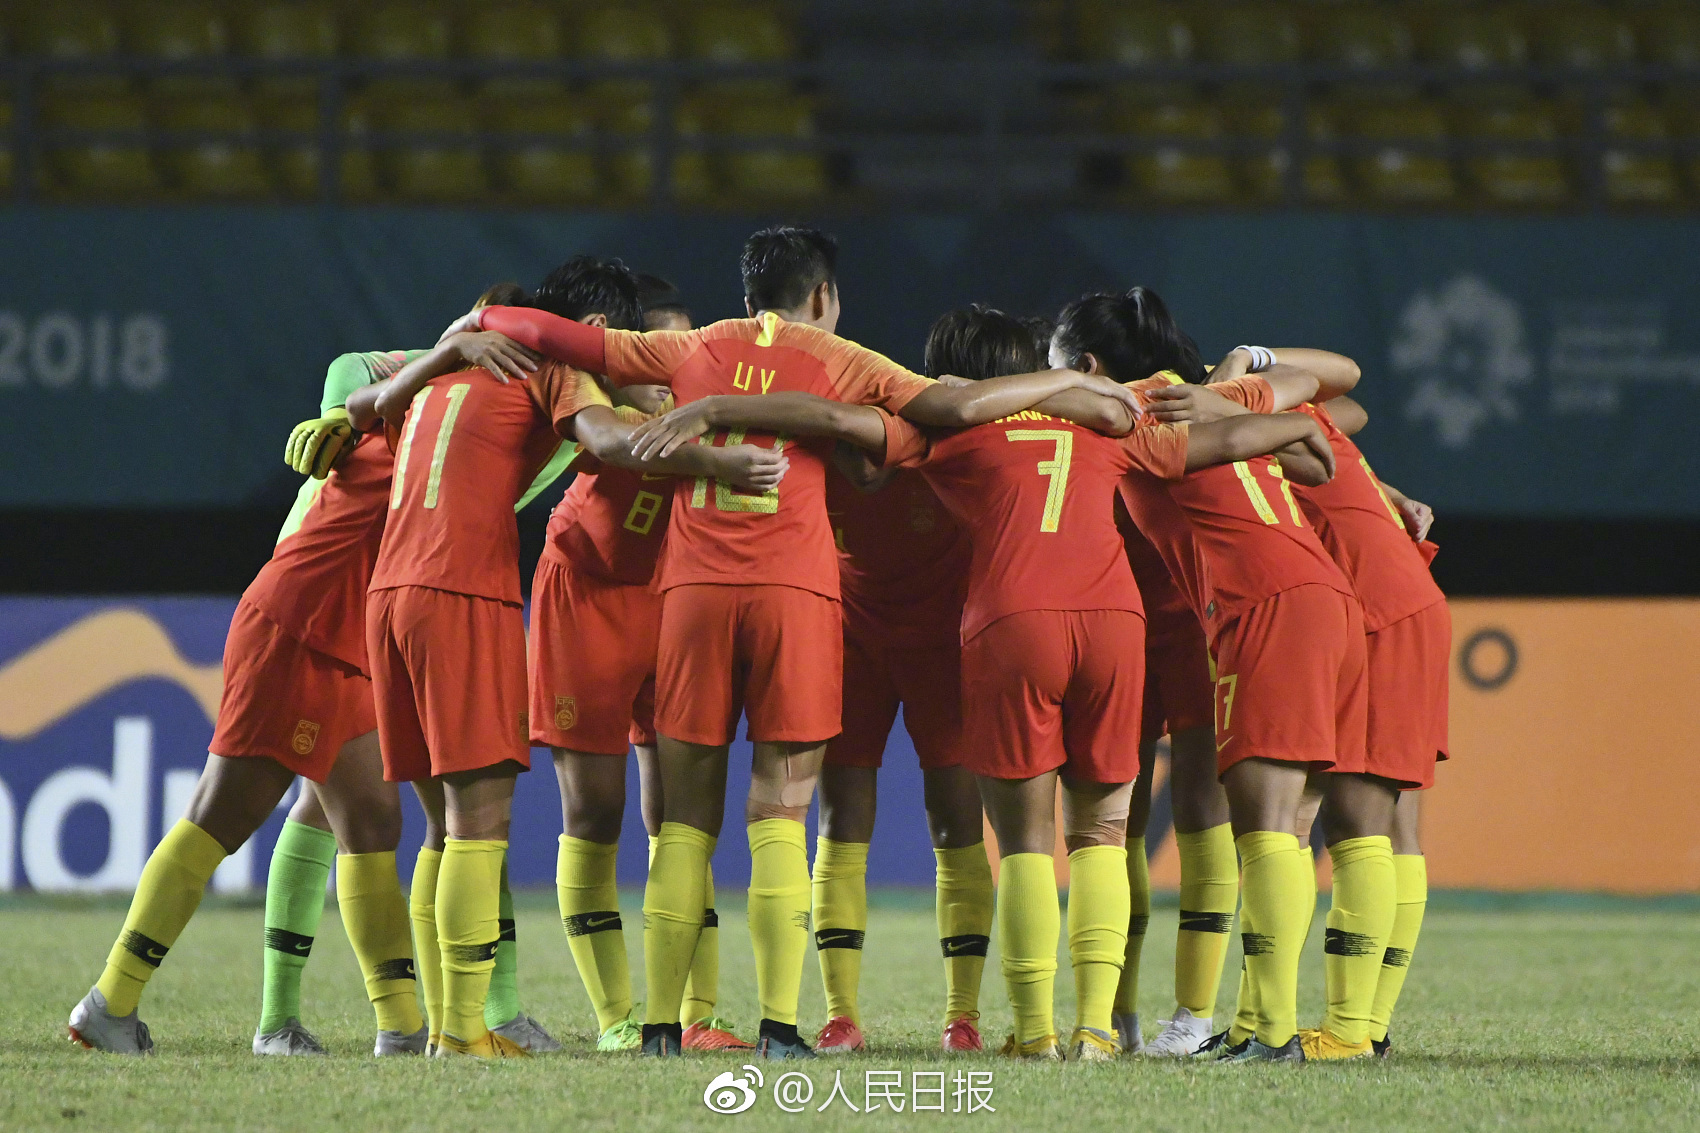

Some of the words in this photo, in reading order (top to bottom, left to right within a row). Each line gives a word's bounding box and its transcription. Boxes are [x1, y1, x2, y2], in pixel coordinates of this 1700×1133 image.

[0, 314, 169, 388] 2018
[391, 383, 471, 509] 11
[1005, 429, 1073, 533] 7
[623, 490, 663, 535] 8
